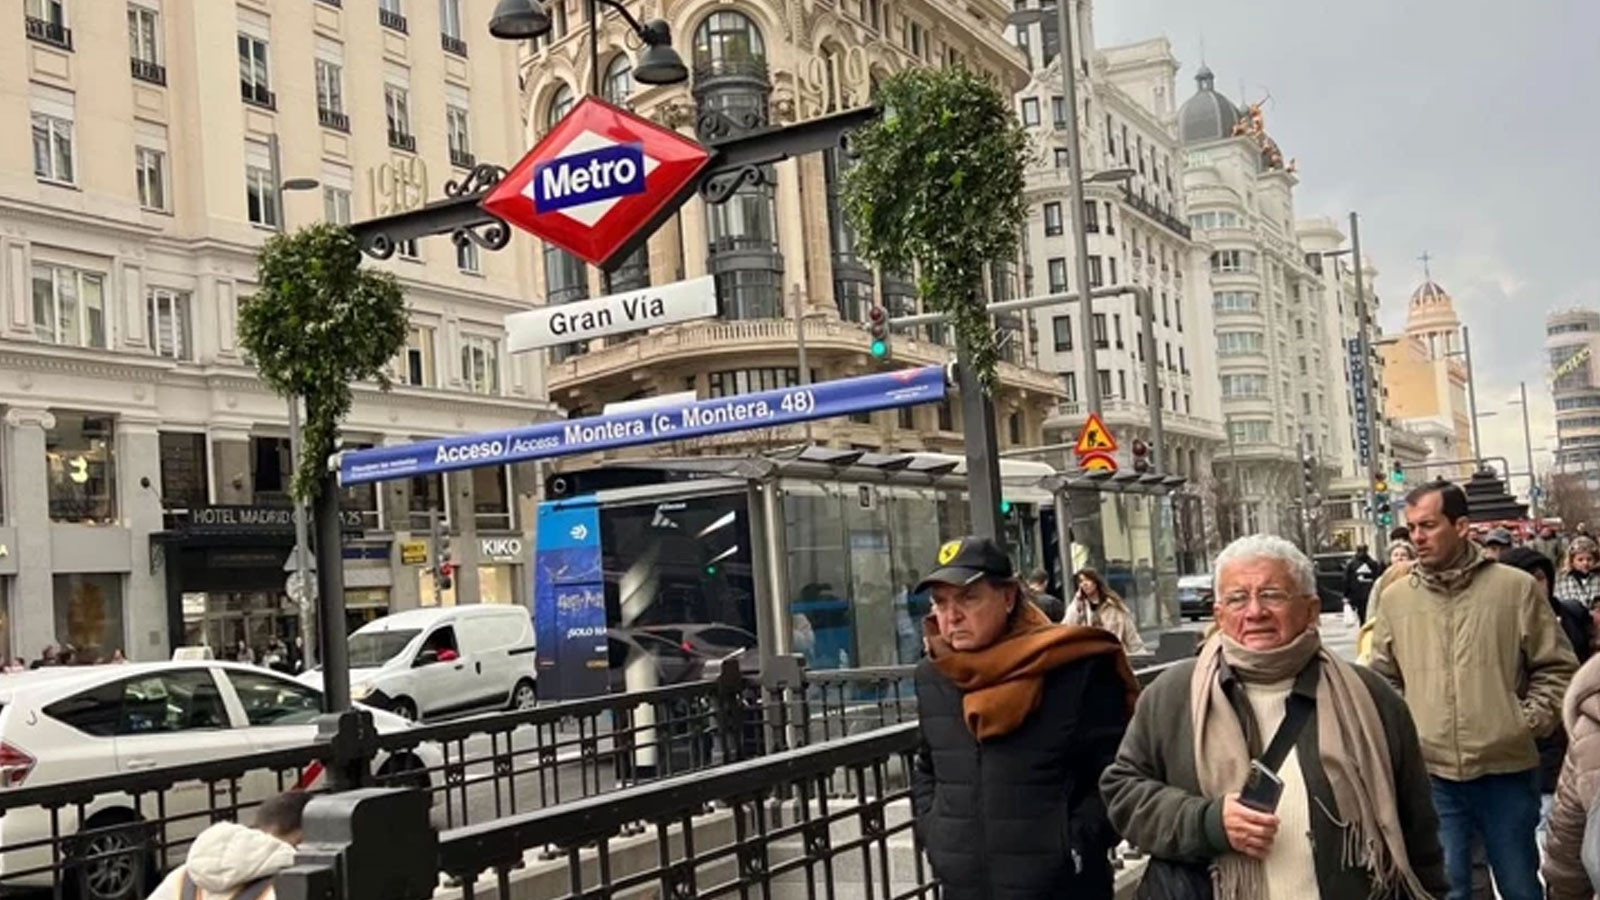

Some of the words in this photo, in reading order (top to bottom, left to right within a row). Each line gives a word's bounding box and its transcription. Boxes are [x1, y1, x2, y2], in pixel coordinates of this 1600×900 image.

[793, 45, 869, 121] 1919
[542, 157, 636, 200] Metro
[549, 308, 612, 336] Gran
[622, 296, 665, 321] Vía
[564, 420, 645, 445] Montera
[651, 412, 676, 437] (c.
[682, 400, 774, 428] Montera,
[781, 390, 814, 414] 48)
[193, 508, 238, 524] HOTEL
[240, 509, 290, 524] MADRID
[482, 539, 521, 555] KIKO
